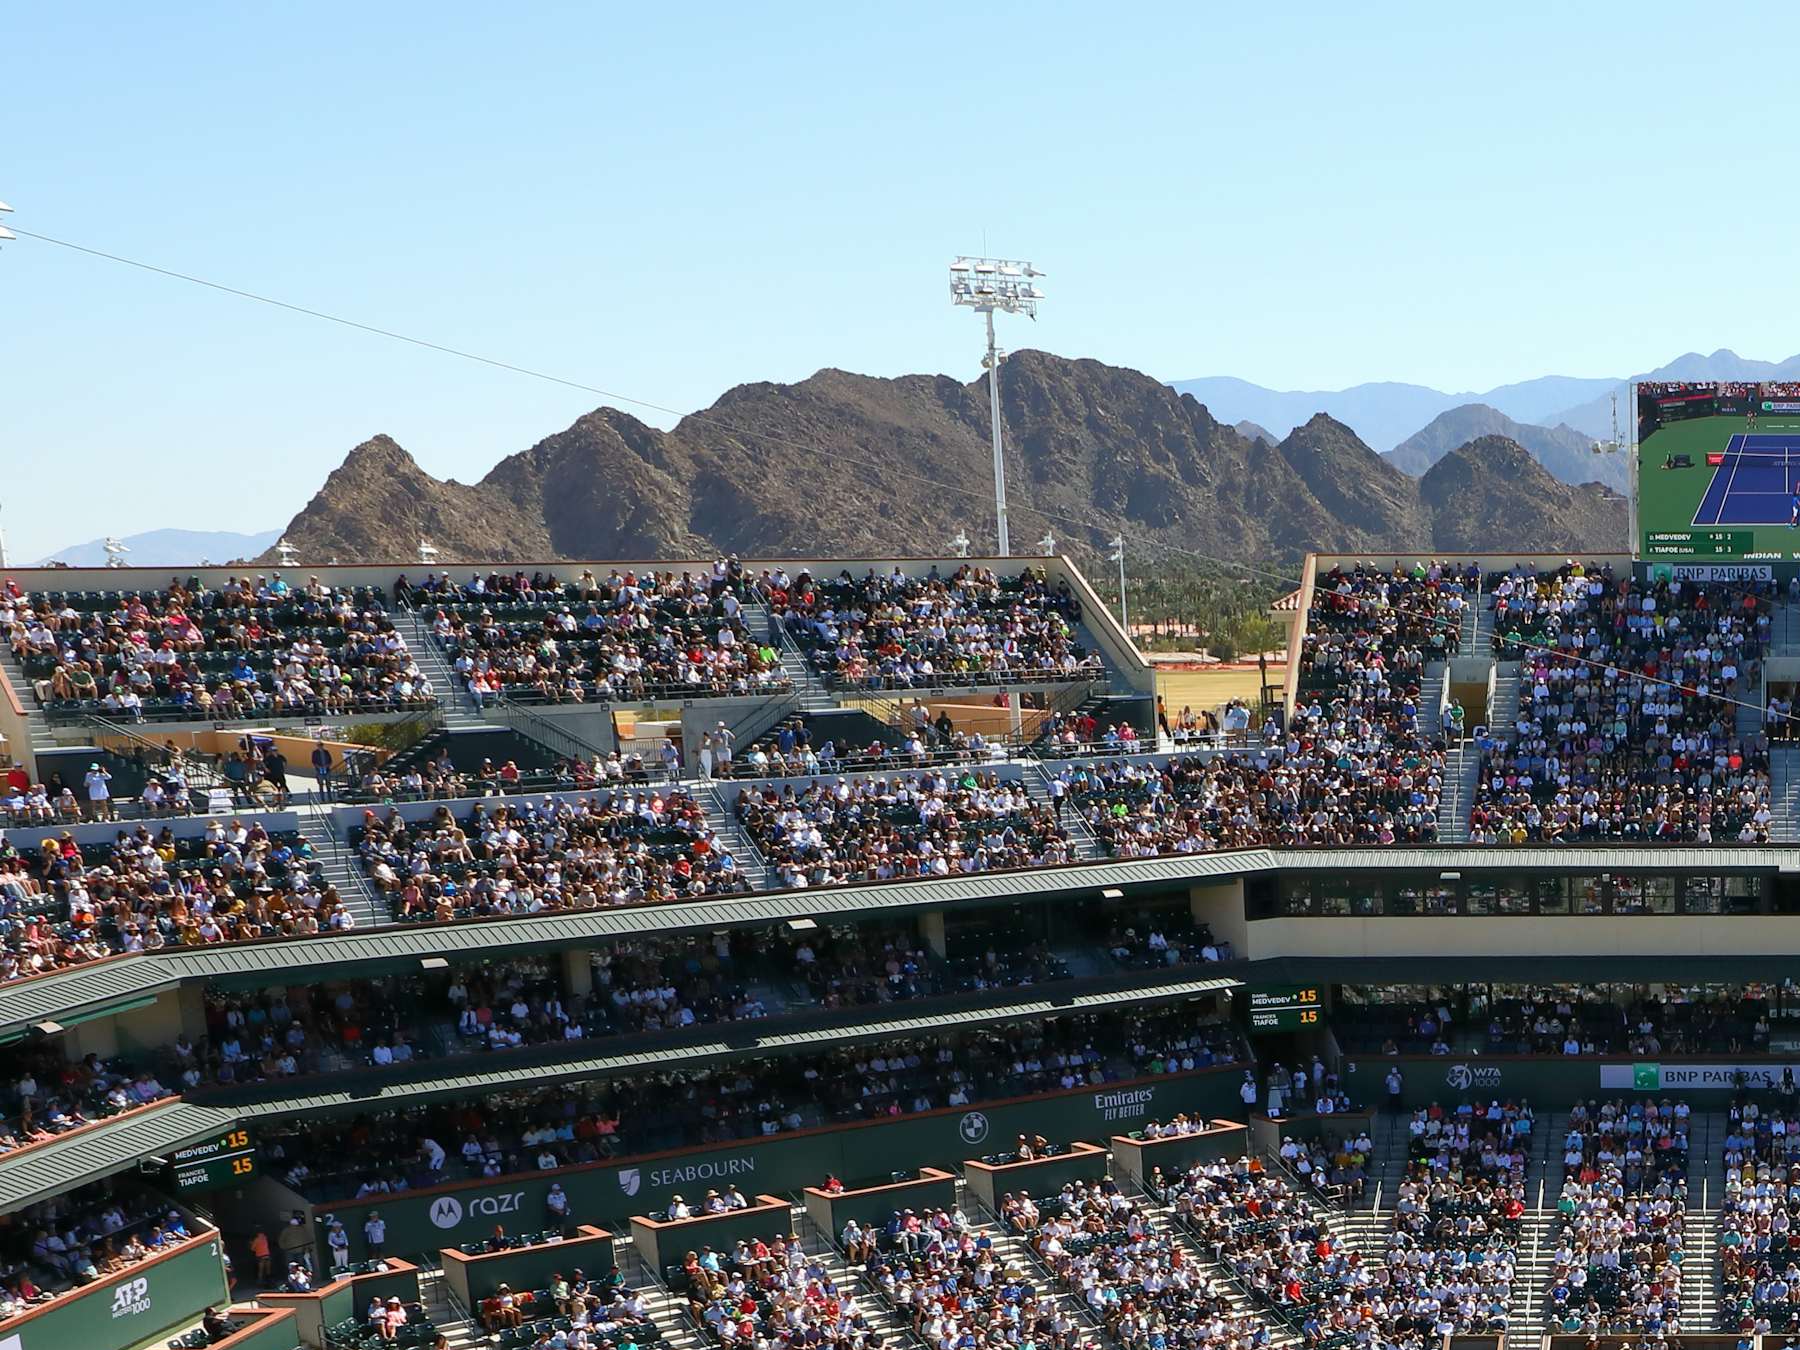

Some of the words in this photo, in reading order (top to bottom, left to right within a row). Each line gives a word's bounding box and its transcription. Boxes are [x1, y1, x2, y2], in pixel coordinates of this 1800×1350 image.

[1677, 567, 1704, 580] BNP
[1711, 567, 1767, 580] PARIBAS
[1252, 997, 1291, 1005] MEDVEDEV
[1299, 990, 1316, 1002] 15
[1300, 1011, 1317, 1023] 15
[1349, 1062, 1356, 1073] 3
[1473, 1067, 1501, 1077] WTA
[1475, 1078, 1500, 1087] 1000
[1665, 1071, 1698, 1082] BNP
[1703, 1071, 1771, 1082] PARBAS
[1095, 1088, 1152, 1109] Emirates
[1104, 1108, 1118, 1120] FLY
[1119, 1104, 1145, 1119] BETTER
[175, 1143, 220, 1159] MEDVEDEV
[228, 1130, 248, 1148] 15
[179, 1173, 209, 1187] TIAFOE
[232, 1157, 253, 1175] 15
[650, 1157, 755, 1187] SEABOURN
[469, 1192, 525, 1217] razr
[211, 1242, 218, 1256] 2
[110, 1277, 148, 1312] ATP
[131, 1298, 151, 1316] 1000
